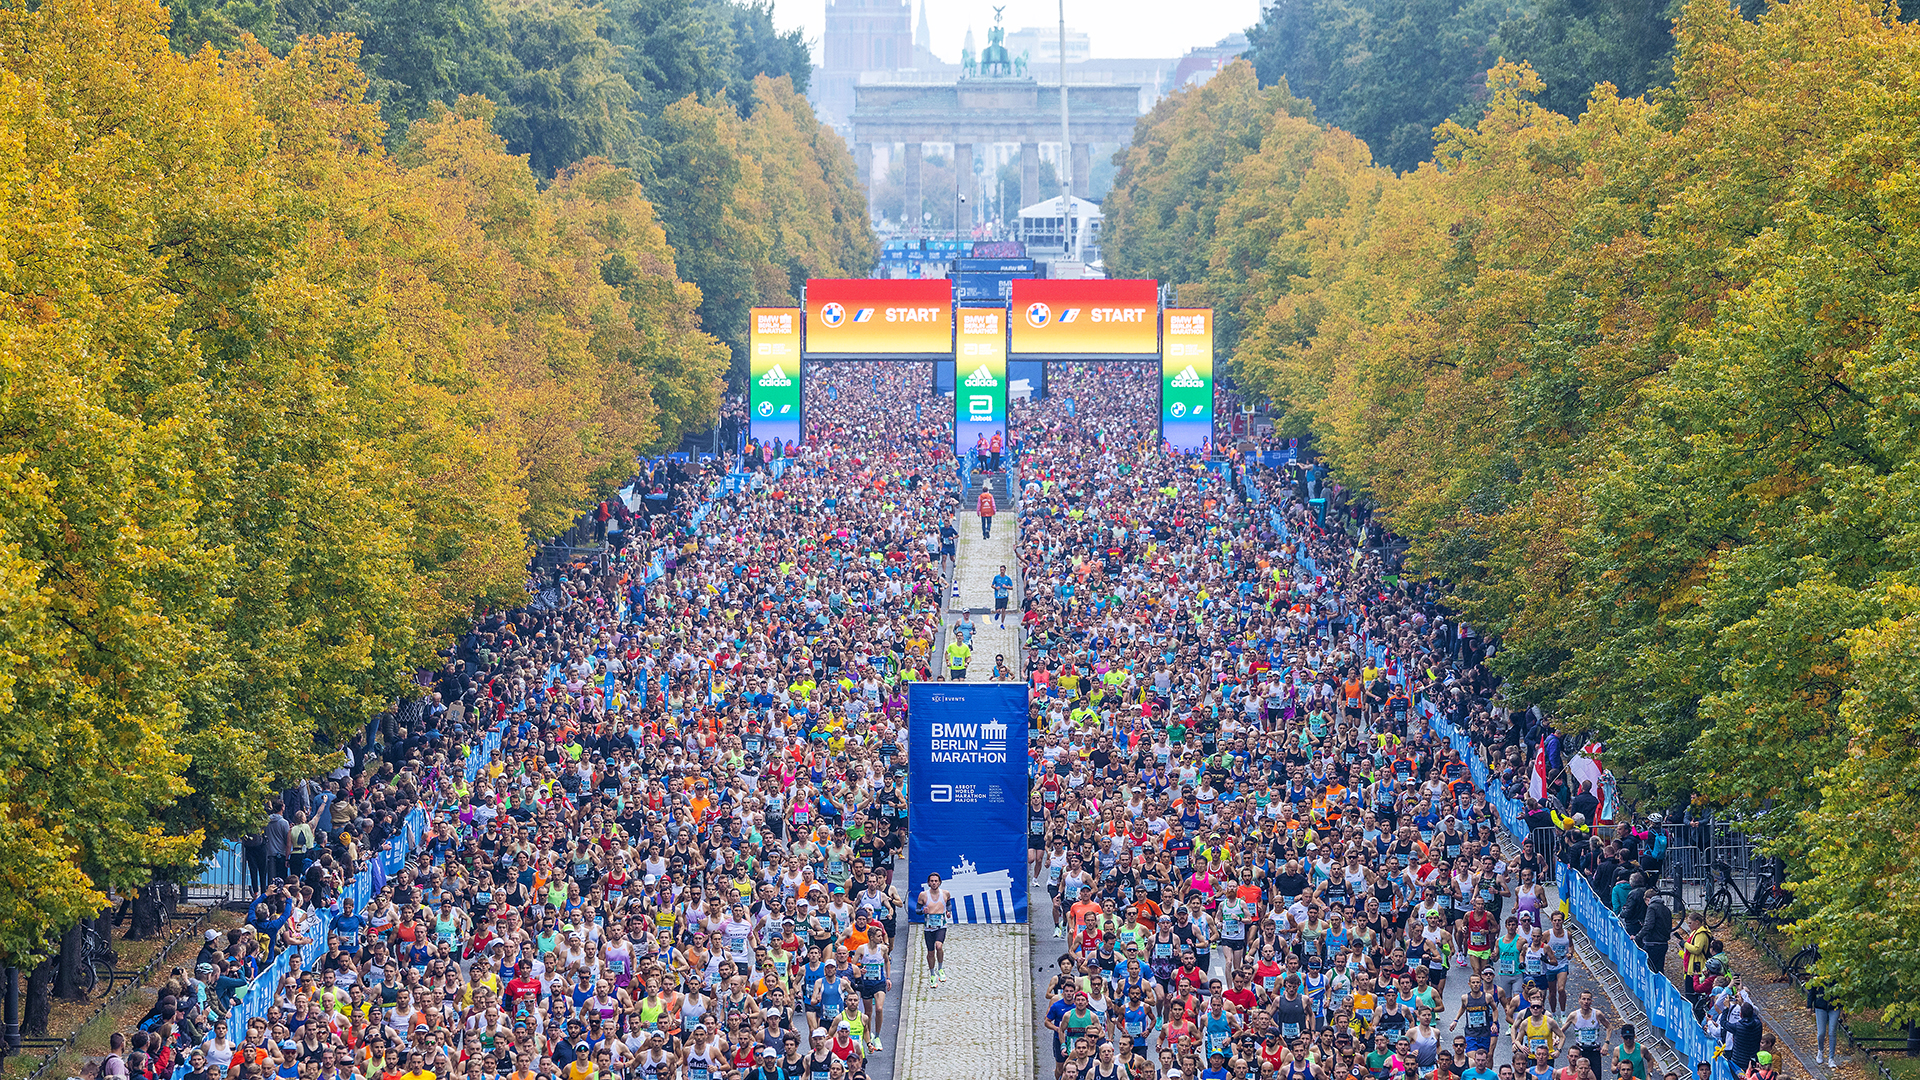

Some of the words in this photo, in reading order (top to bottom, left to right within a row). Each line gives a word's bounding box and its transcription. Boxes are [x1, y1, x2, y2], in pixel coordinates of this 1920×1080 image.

[758, 315, 779, 323] BMW
[885, 308, 940, 322] START
[1091, 308, 1146, 322] START
[1170, 316, 1192, 324] BMW
[931, 723, 978, 738] BMW
[931, 739, 978, 750] BERLIN
[931, 752, 1007, 763] MARATHON
